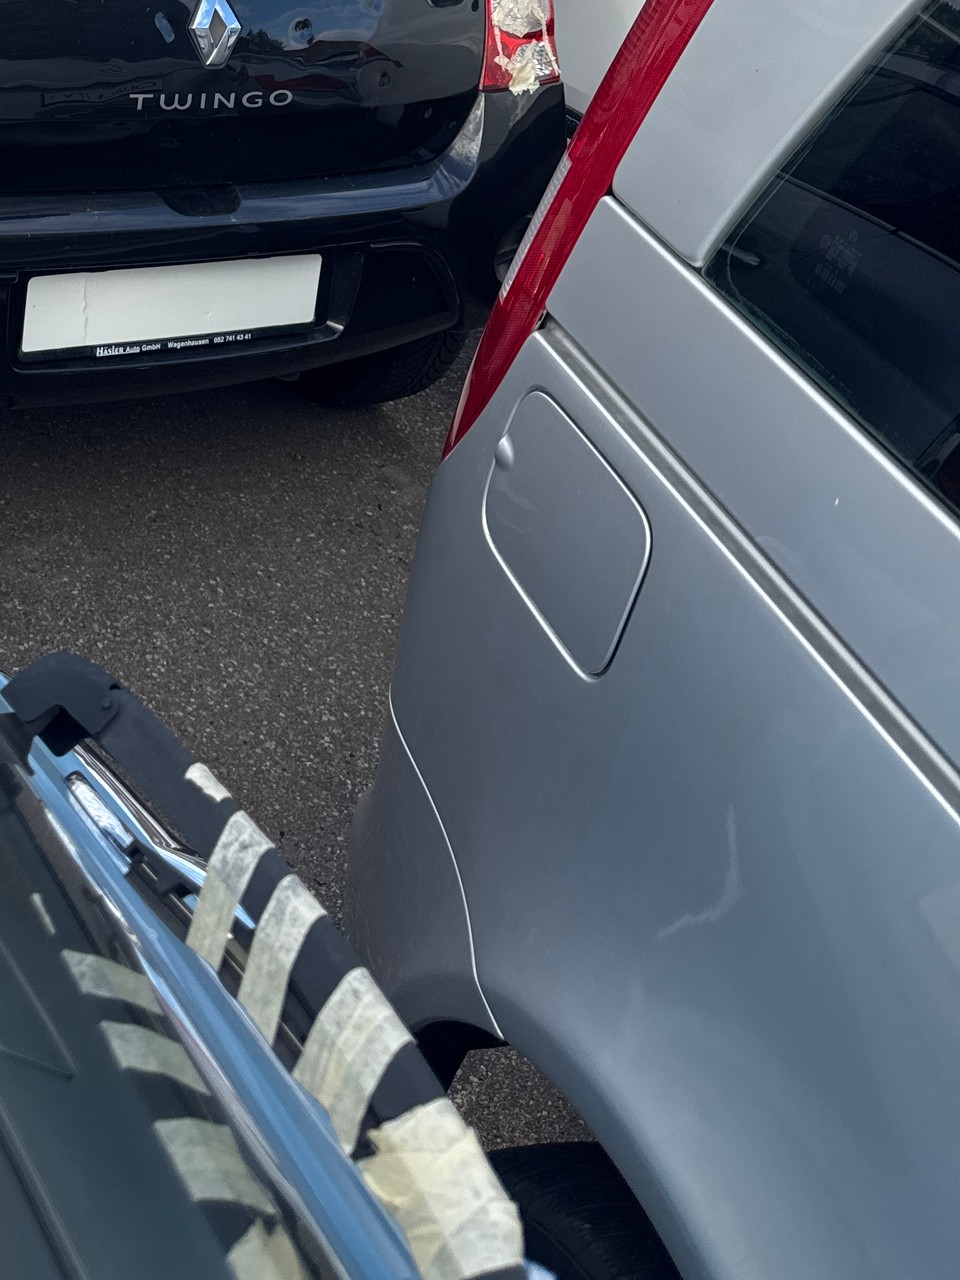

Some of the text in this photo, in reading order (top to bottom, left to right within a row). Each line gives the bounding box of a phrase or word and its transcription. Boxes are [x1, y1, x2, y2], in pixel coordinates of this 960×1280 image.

[128, 89, 294, 111] TWINGO
[125, 345, 140, 355] Auto
[141, 342, 161, 352] GmbH
[167, 338, 209, 350] Wagenhausen
[213, 335, 225, 344] 052
